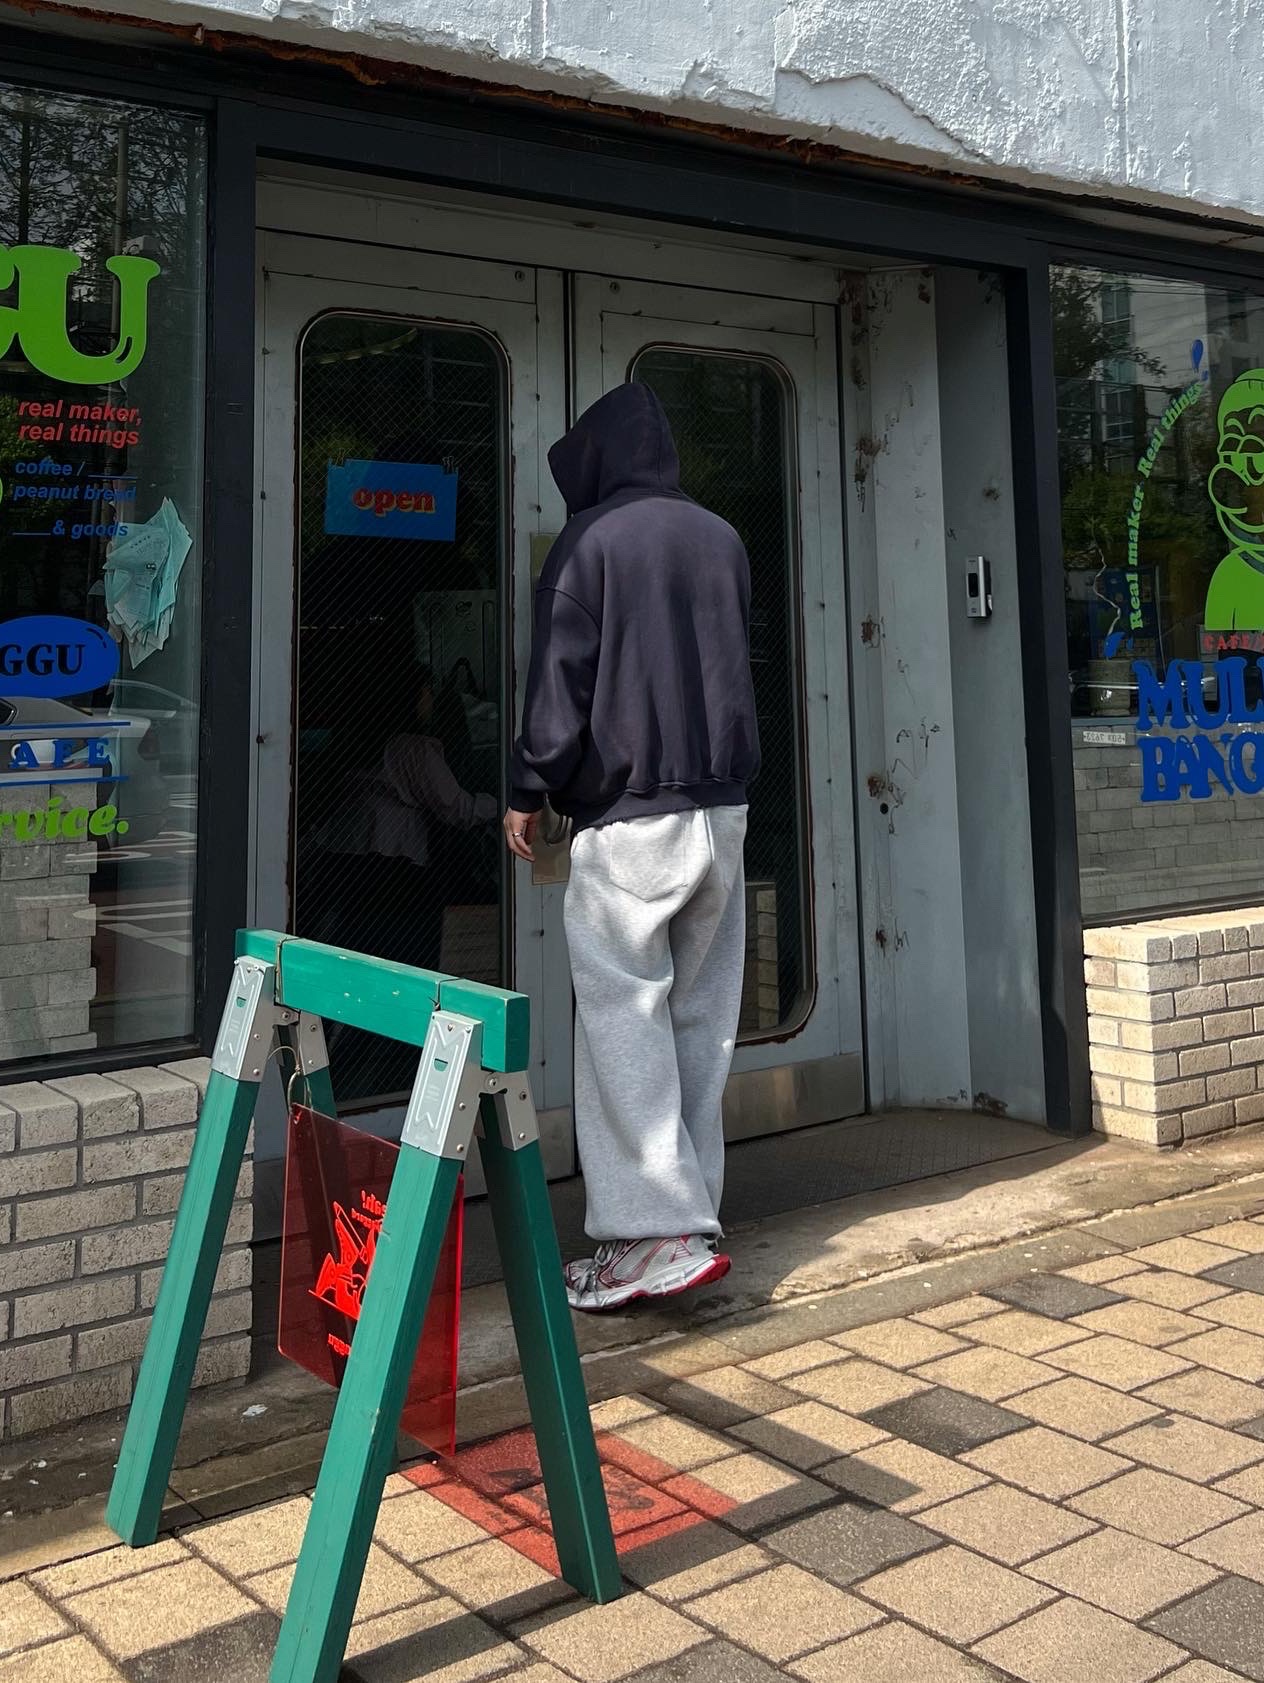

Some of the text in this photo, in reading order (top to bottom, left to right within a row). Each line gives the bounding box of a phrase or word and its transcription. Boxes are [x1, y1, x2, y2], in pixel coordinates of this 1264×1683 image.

[0, 243, 161, 385] U
[17, 400, 142, 427] real maker,
[18, 422, 140, 448] real things
[15, 456, 73, 477] coffee
[13, 484, 138, 501] peanut bread
[352, 487, 437, 518] open
[1126, 573, 1144, 630] Real
[1136, 427, 1165, 478] Real
[1160, 382, 1203, 430] things
[52, 519, 129, 540] & goods
[1130, 656, 1264, 732] MUL
